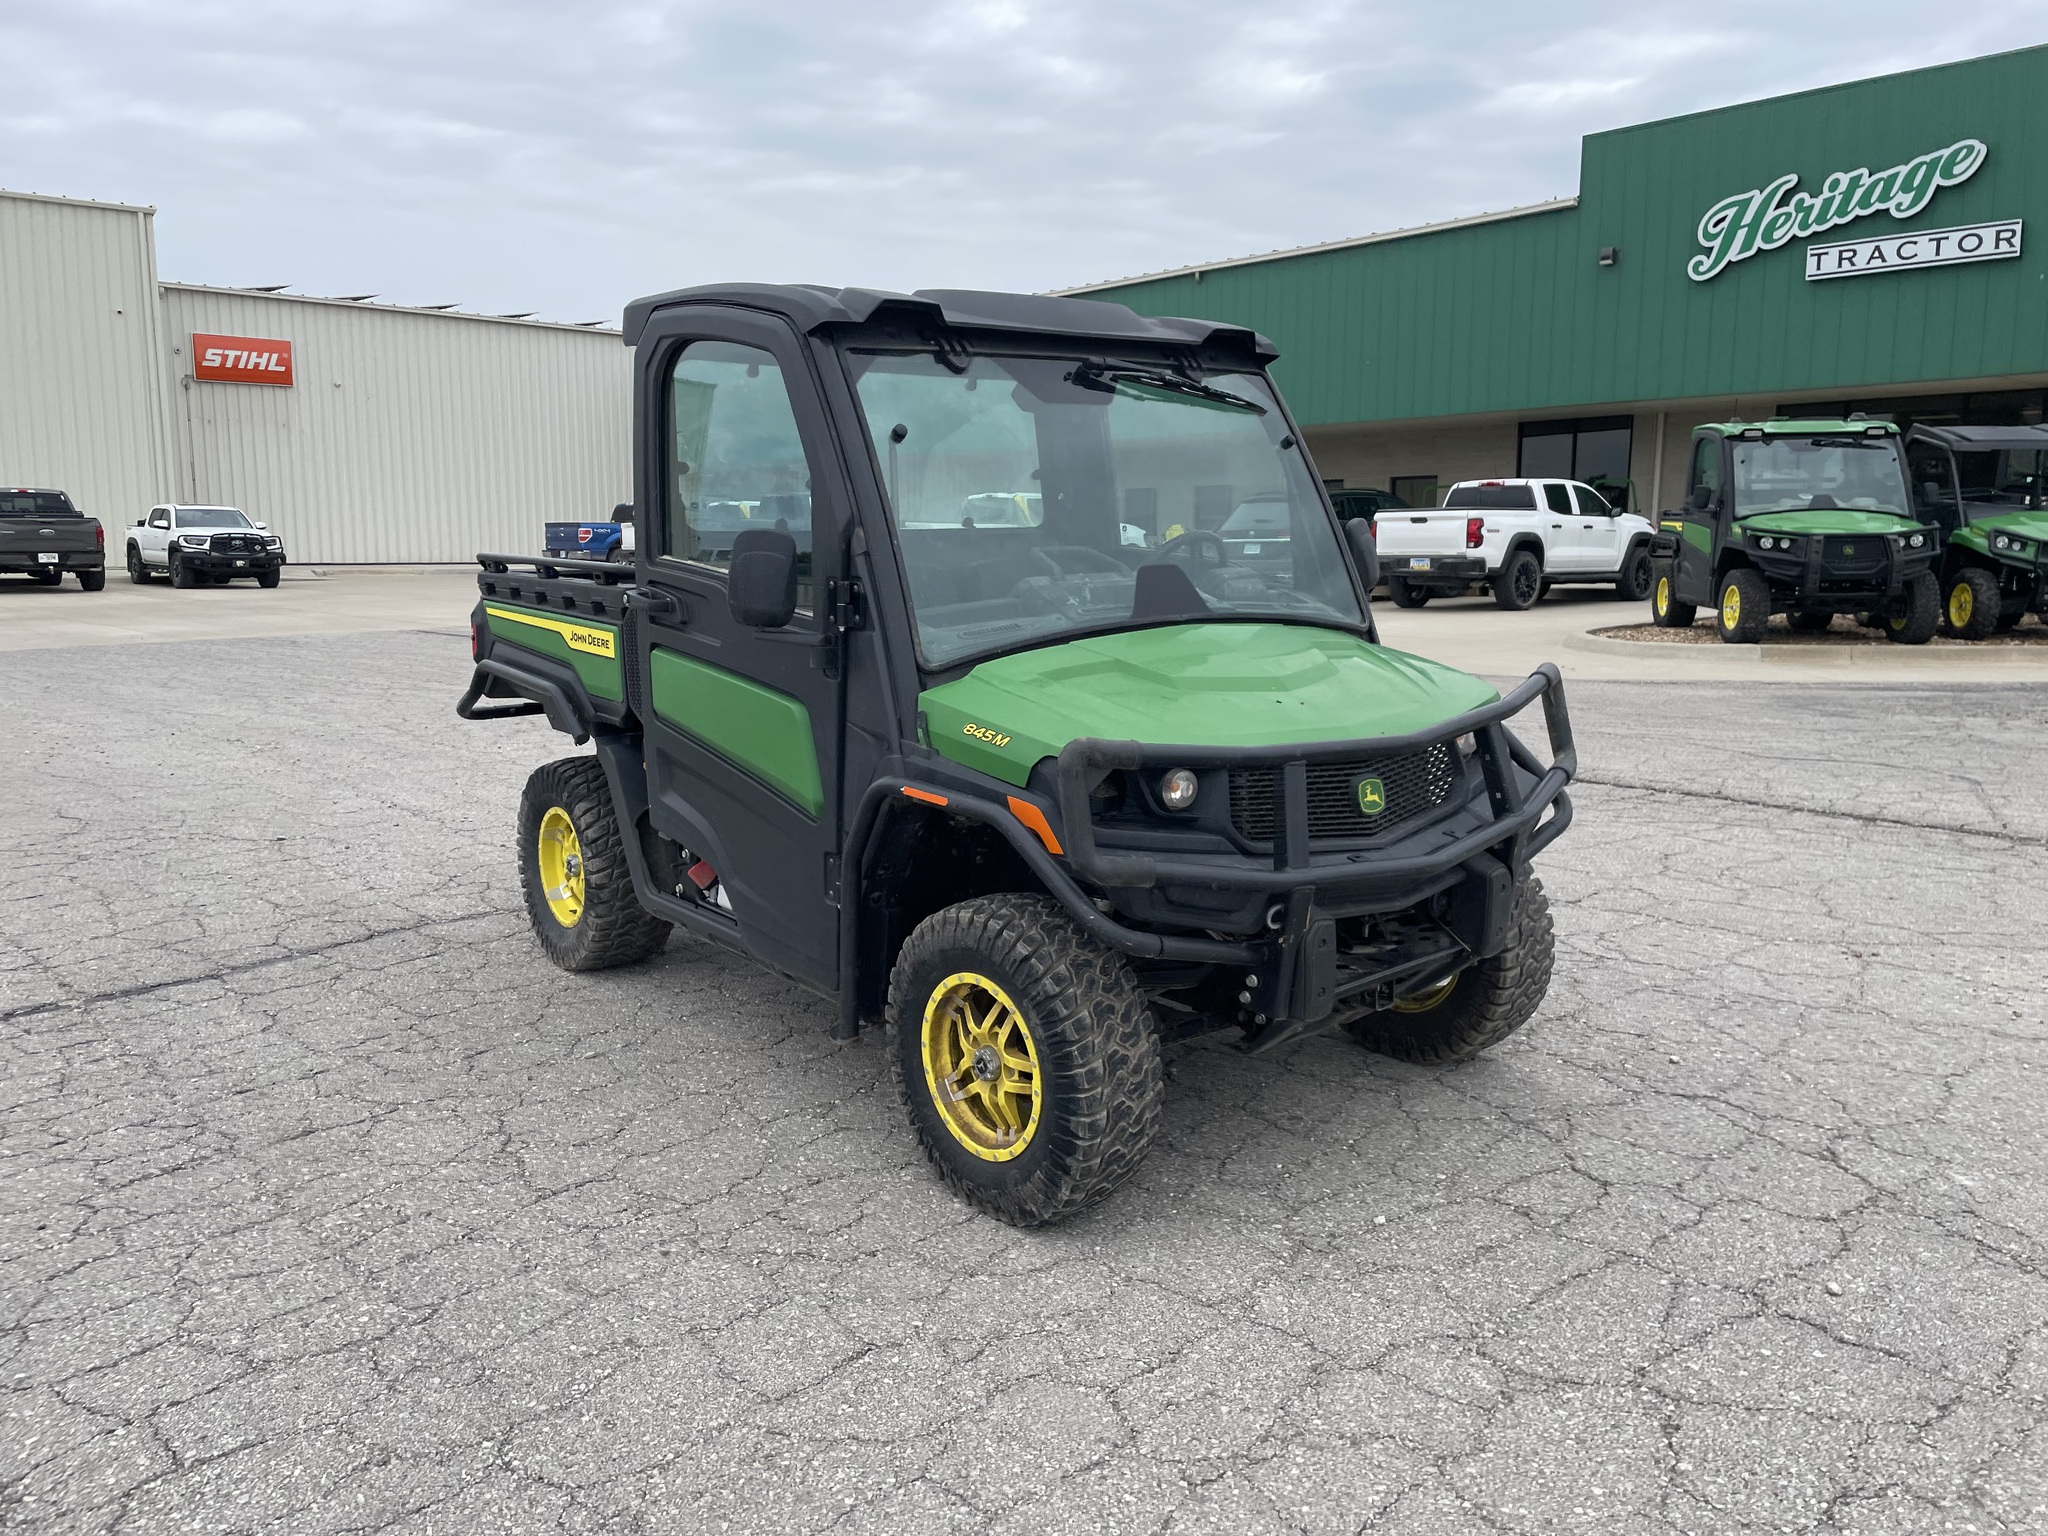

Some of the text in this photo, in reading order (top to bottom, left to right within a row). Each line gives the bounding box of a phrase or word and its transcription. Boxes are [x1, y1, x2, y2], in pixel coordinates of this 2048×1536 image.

[1690, 141, 1985, 279] Heritage
[1809, 228, 2017, 272] TRACTOR
[201, 348, 286, 372] STIHL
[570, 631, 610, 649] JOHN DEERE
[962, 722, 1012, 748] 845M
